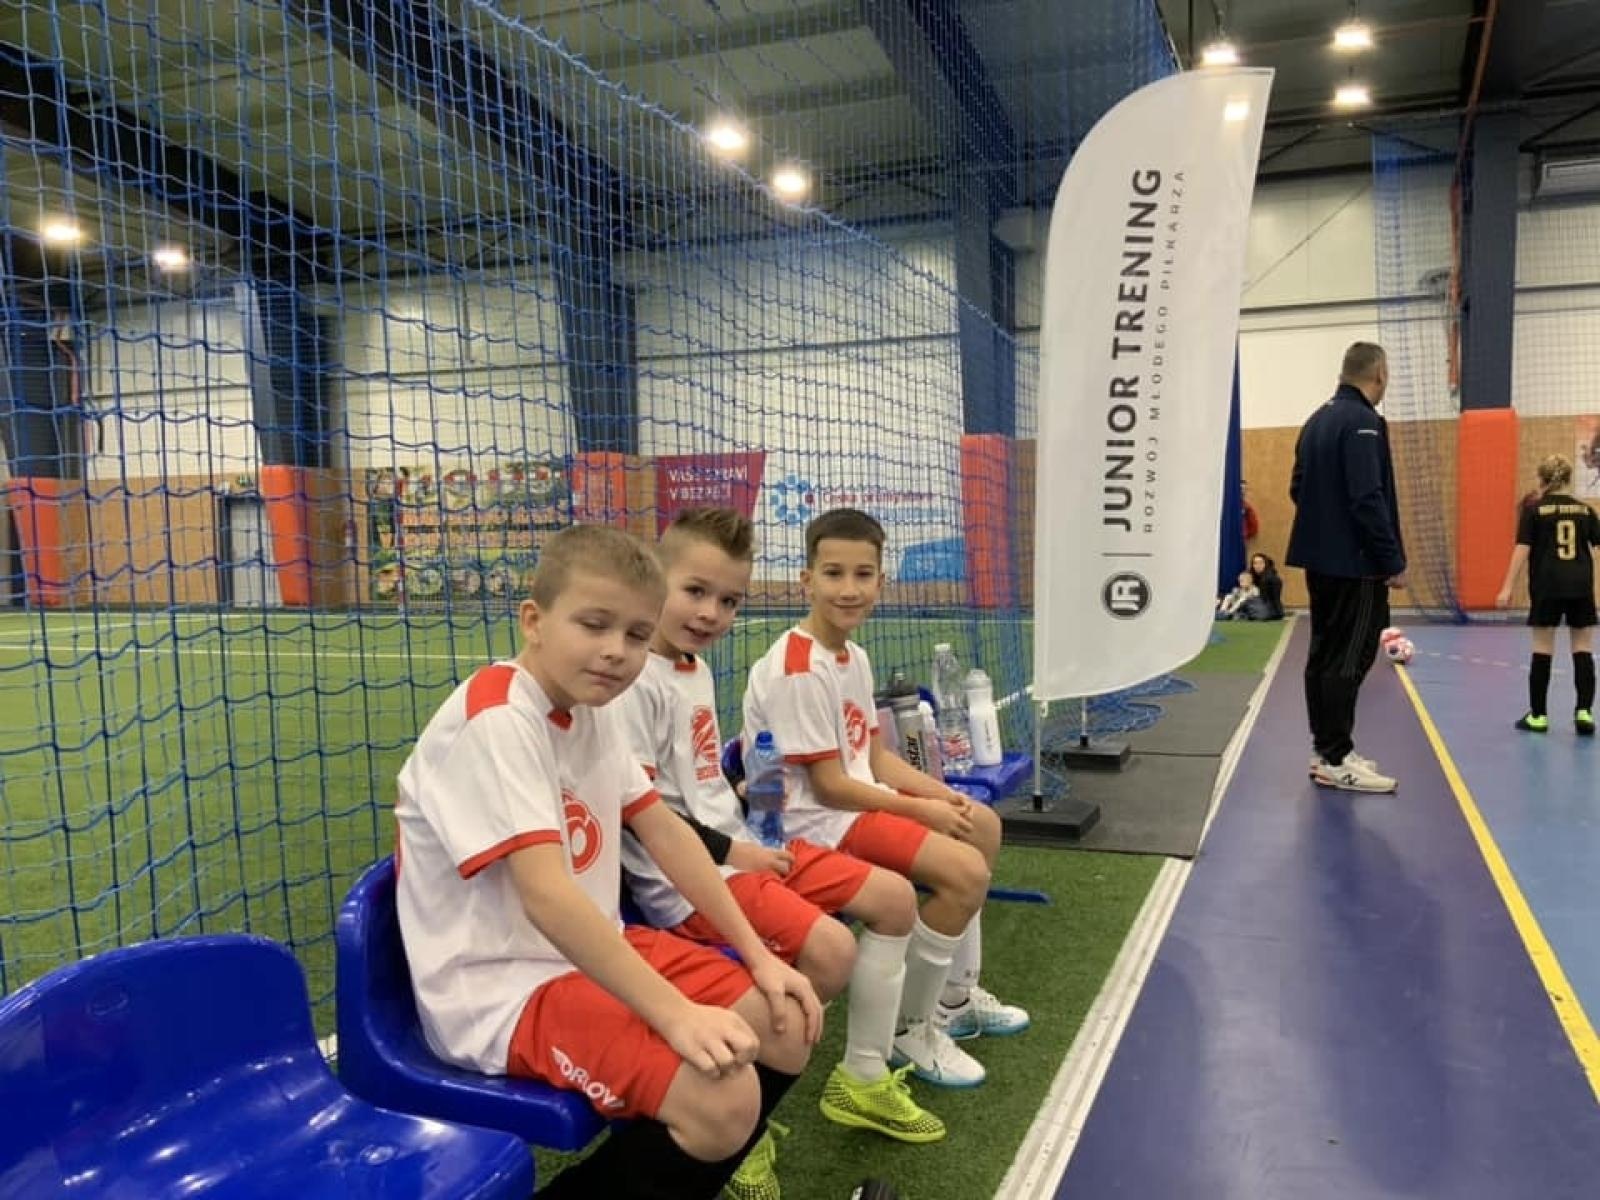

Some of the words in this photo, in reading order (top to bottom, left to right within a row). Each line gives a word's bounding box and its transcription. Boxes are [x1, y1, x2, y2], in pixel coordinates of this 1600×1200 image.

[1111, 169, 1162, 360] TRENING
[1103, 375, 1140, 532] JUNIOR
[1556, 519, 1577, 561] 9
